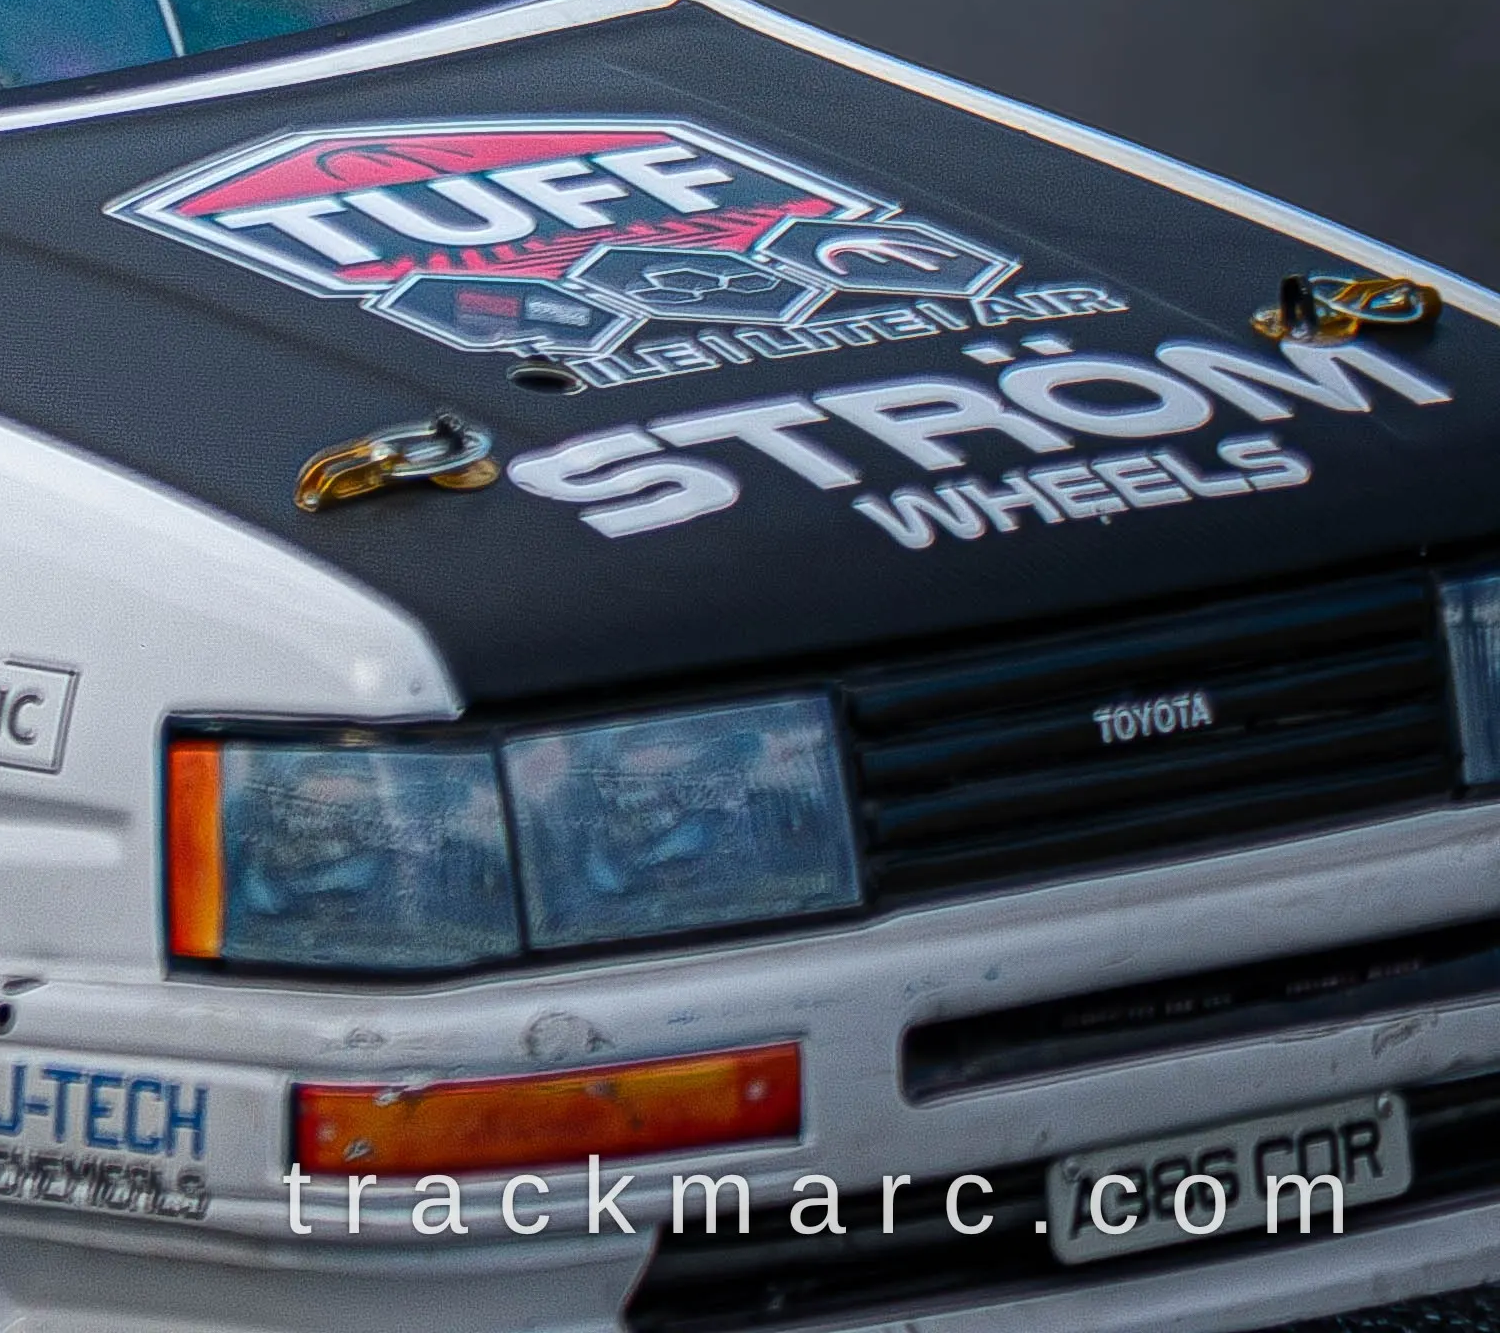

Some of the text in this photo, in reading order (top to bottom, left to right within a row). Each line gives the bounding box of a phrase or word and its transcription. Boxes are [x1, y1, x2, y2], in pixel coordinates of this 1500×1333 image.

[212, 140, 743, 272] TUFF
[969, 287, 1132, 328] AIR
[503, 335, 1455, 540] STRÖM
[852, 435, 1313, 552] WHEELS
[1092, 691, 1213, 745] TOYOTA
[1253, 1119, 1385, 1200] COR
